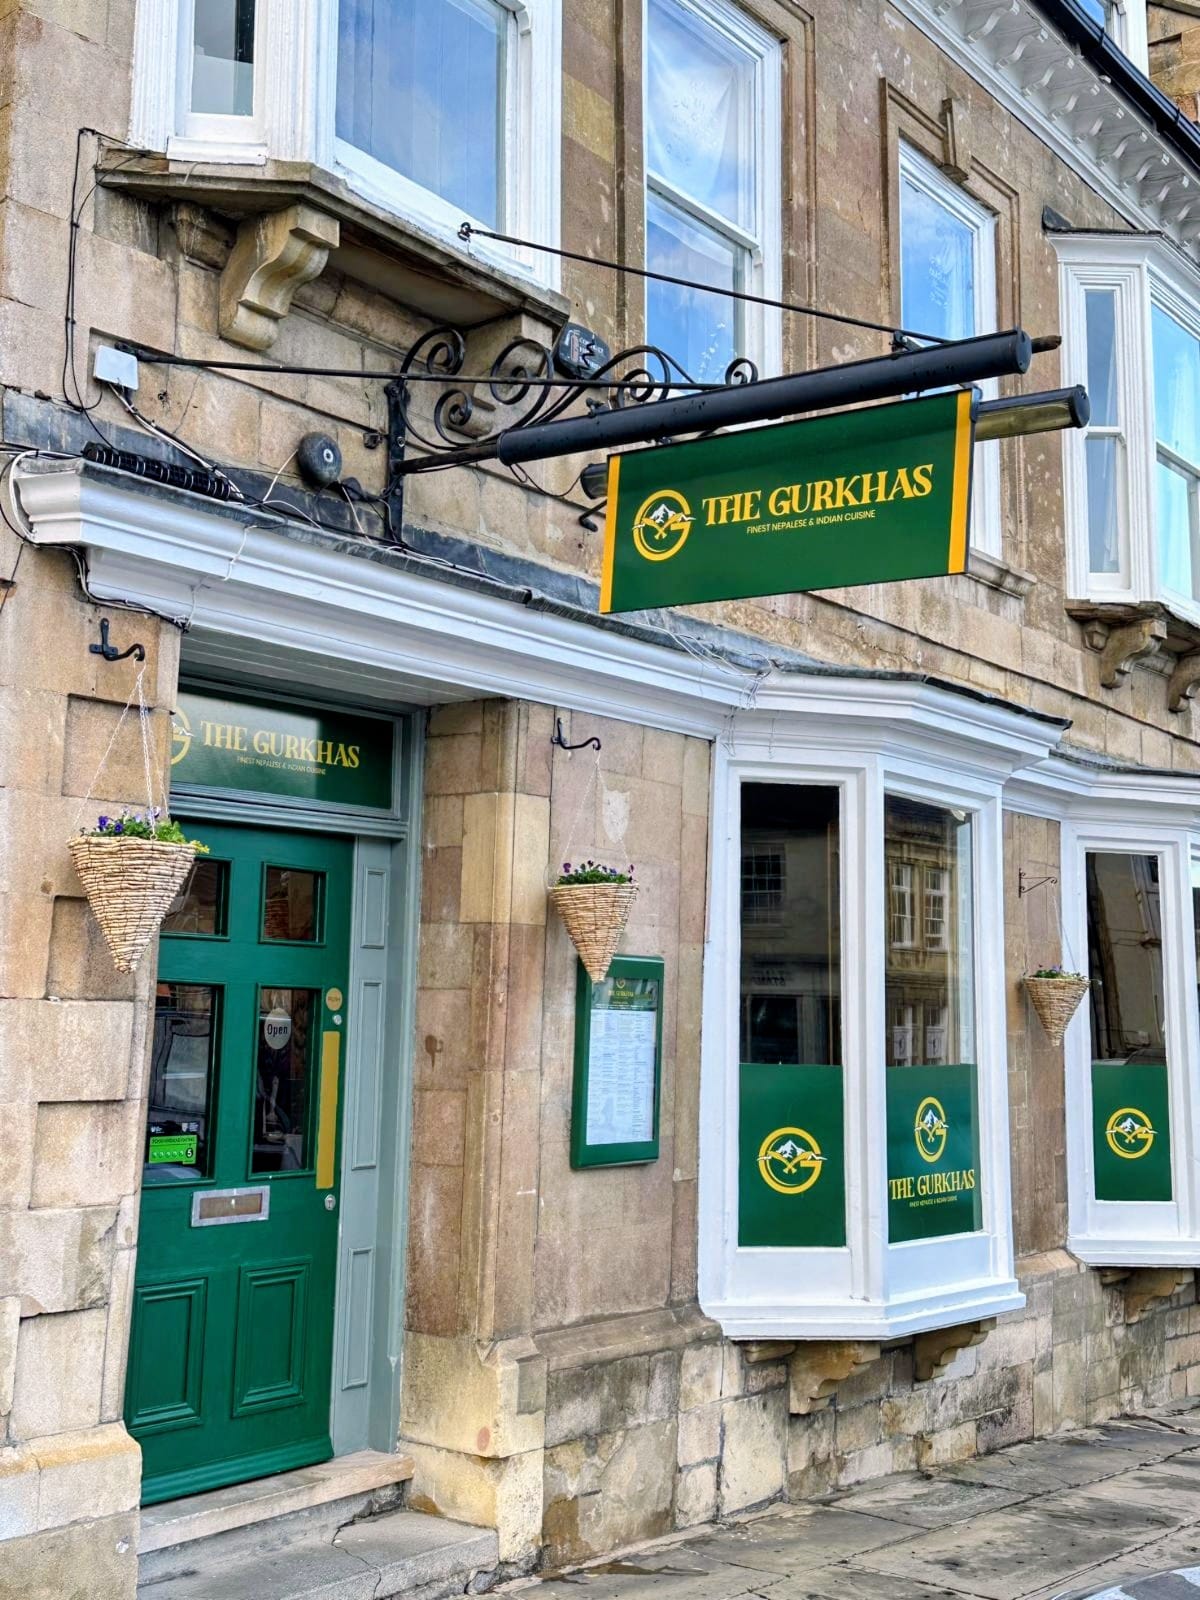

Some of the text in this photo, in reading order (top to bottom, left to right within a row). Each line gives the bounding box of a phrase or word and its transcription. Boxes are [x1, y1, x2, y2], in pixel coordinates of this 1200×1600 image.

[702, 464, 933, 526] THE GURKHAS
[746, 509, 876, 534] FINEST NEPALESE & INDIAN CUISINE
[200, 720, 360, 768] THE GURKHAS
[267, 1023, 288, 1038] Open
[889, 1169, 975, 1200] THE GURKHAS
